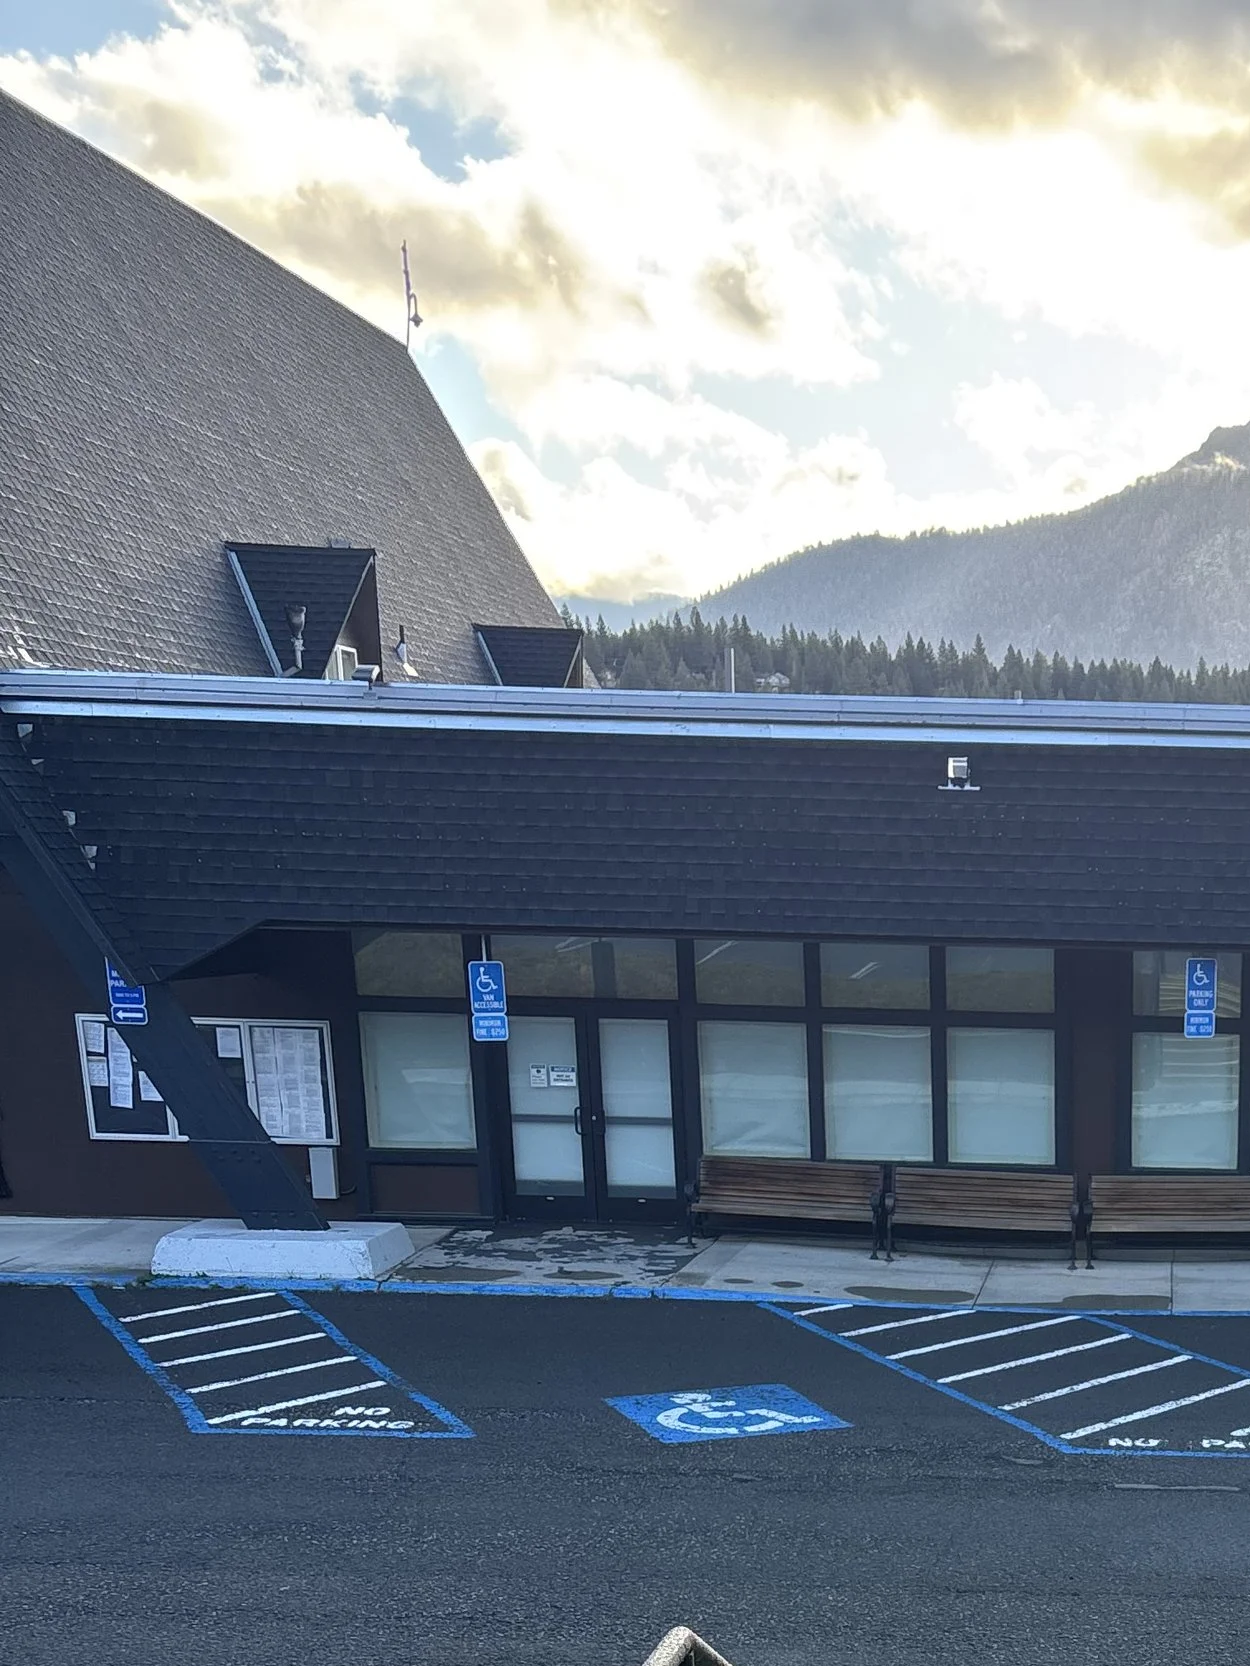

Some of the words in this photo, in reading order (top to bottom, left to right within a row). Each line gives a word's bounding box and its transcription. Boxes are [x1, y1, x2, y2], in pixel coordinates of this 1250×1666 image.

[1189, 990, 1214, 998] PARKING
[334, 1406, 391, 1416] NO
[240, 1417, 415, 1429] PARKING
[1108, 1438, 1162, 1447] NO
